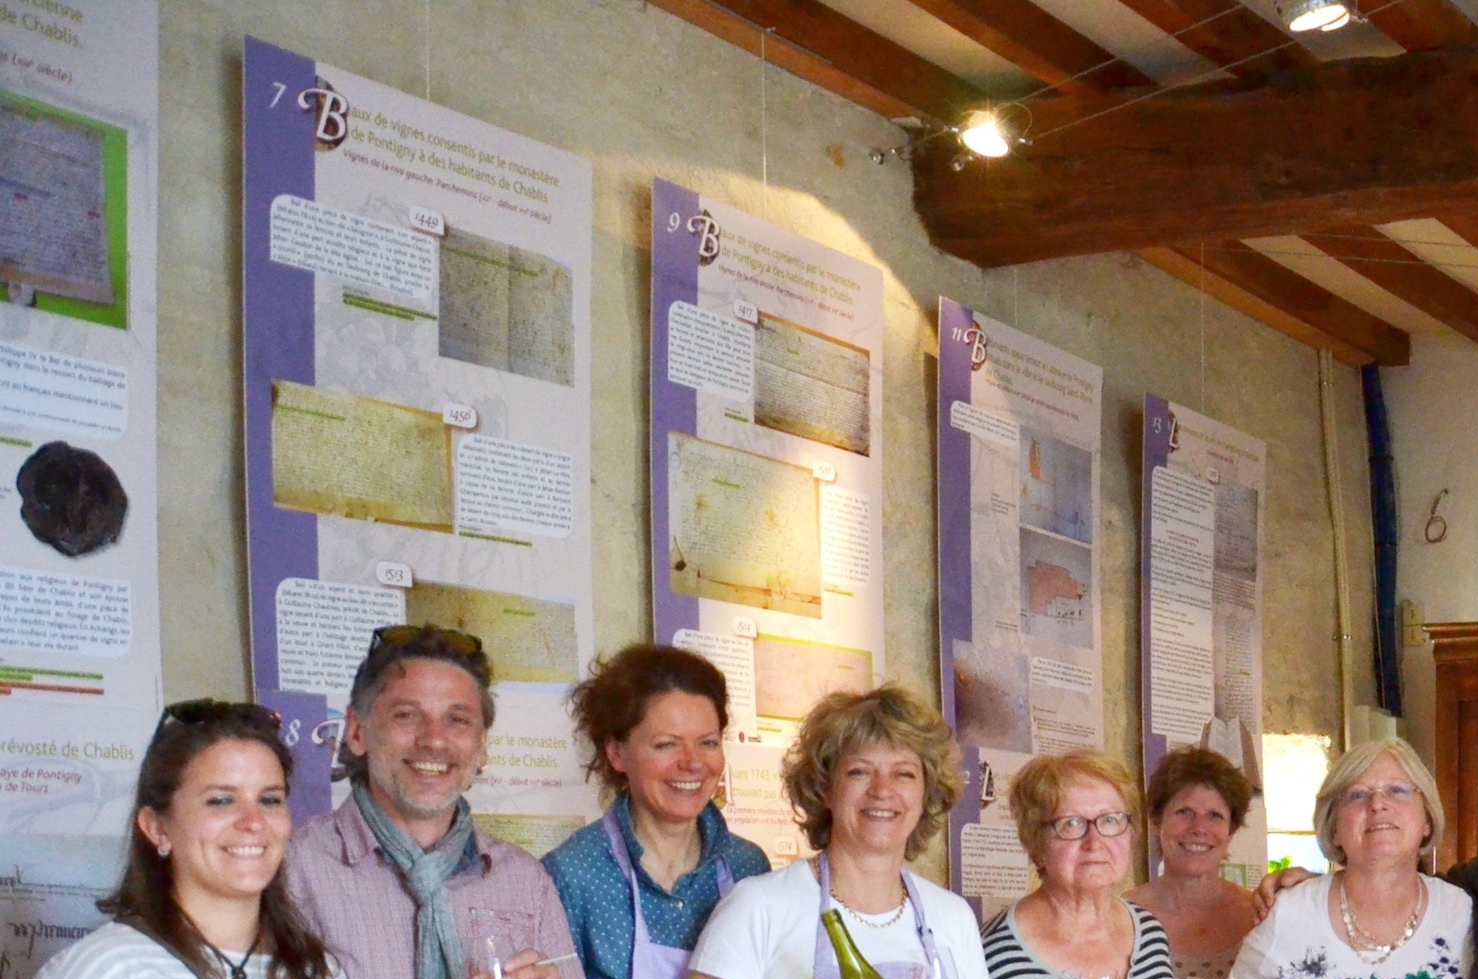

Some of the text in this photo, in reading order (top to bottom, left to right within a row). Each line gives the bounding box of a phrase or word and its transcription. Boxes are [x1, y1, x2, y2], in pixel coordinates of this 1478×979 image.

[269, 81, 288, 109] 7
[374, 110, 389, 128] de
[390, 118, 425, 142] vignes
[427, 132, 477, 159] consentis
[478, 150, 495, 164] par
[497, 155, 507, 168] le
[509, 161, 560, 187] monastère
[342, 147, 370, 165] Vignes
[370, 157, 381, 168] de
[390, 164, 405, 176] rive
[350, 125, 365, 142] de
[367, 130, 417, 163] Pontigny
[418, 148, 426, 162] à
[428, 152, 446, 170] des
[449, 158, 497, 187] habitants
[498, 176, 511, 191] de
[414, 211, 439, 229] 1449
[667, 211, 680, 233] 9
[952, 326, 962, 342] 11
[23, 381, 51, 395] français
[53, 390, 98, 405] mentionnant
[449, 408, 472, 422] 1456
[50, 586, 76, 597] Chablis
[83, 580, 113, 592] Pontigny
[285, 718, 301, 746] 8
[488, 732, 567, 750] par le monastère
[61, 741, 79, 757] de
[83, 742, 135, 760] Chablis
[509, 752, 521, 767] de
[21, 767, 35, 776] de
[37, 768, 83, 785] Pontigny
[5, 781, 49, 793] de Tours
